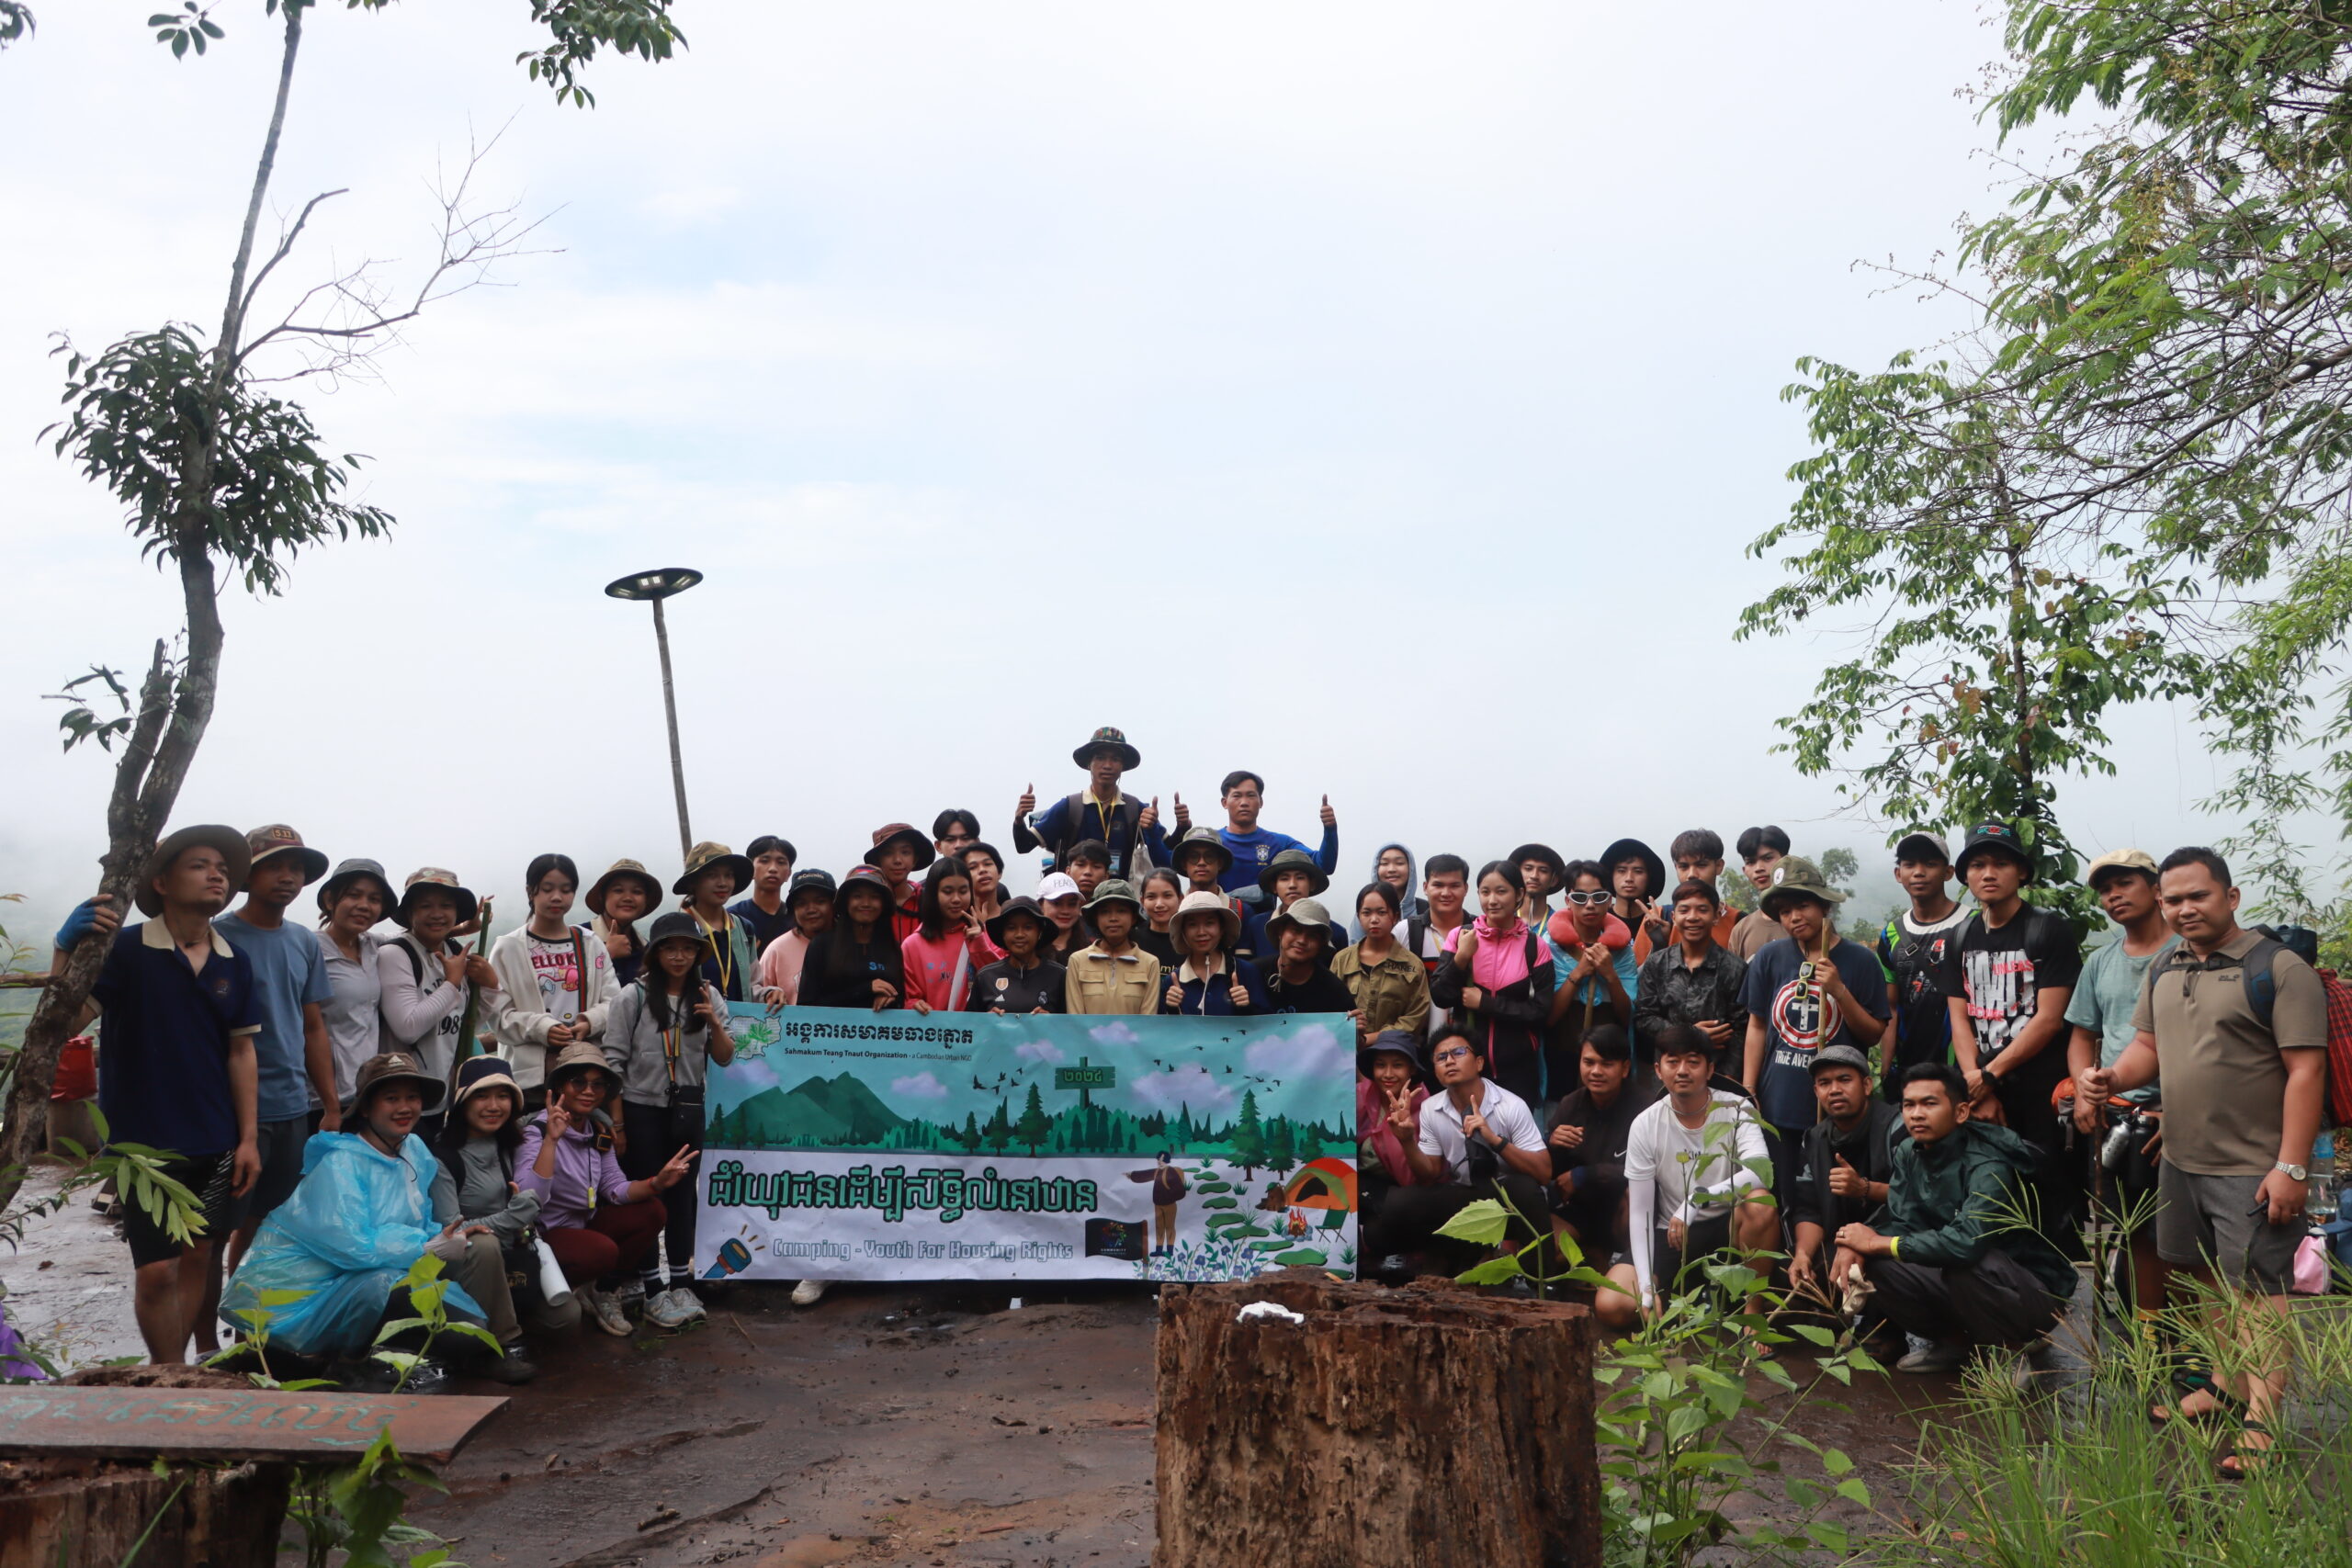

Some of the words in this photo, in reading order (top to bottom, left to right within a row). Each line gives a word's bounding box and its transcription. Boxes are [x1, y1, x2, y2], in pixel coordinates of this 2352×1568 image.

[785, 1047, 822, 1056] Sahmakum
[823, 1049, 843, 1057] Teang
[864, 1050, 908, 1059] Organization
[773, 1238, 852, 1262] Camping
[864, 1240, 913, 1259] Youth
[918, 1241, 945, 1259] For
[949, 1241, 1016, 1262] Housing
[1020, 1242, 1074, 1263] Rights
